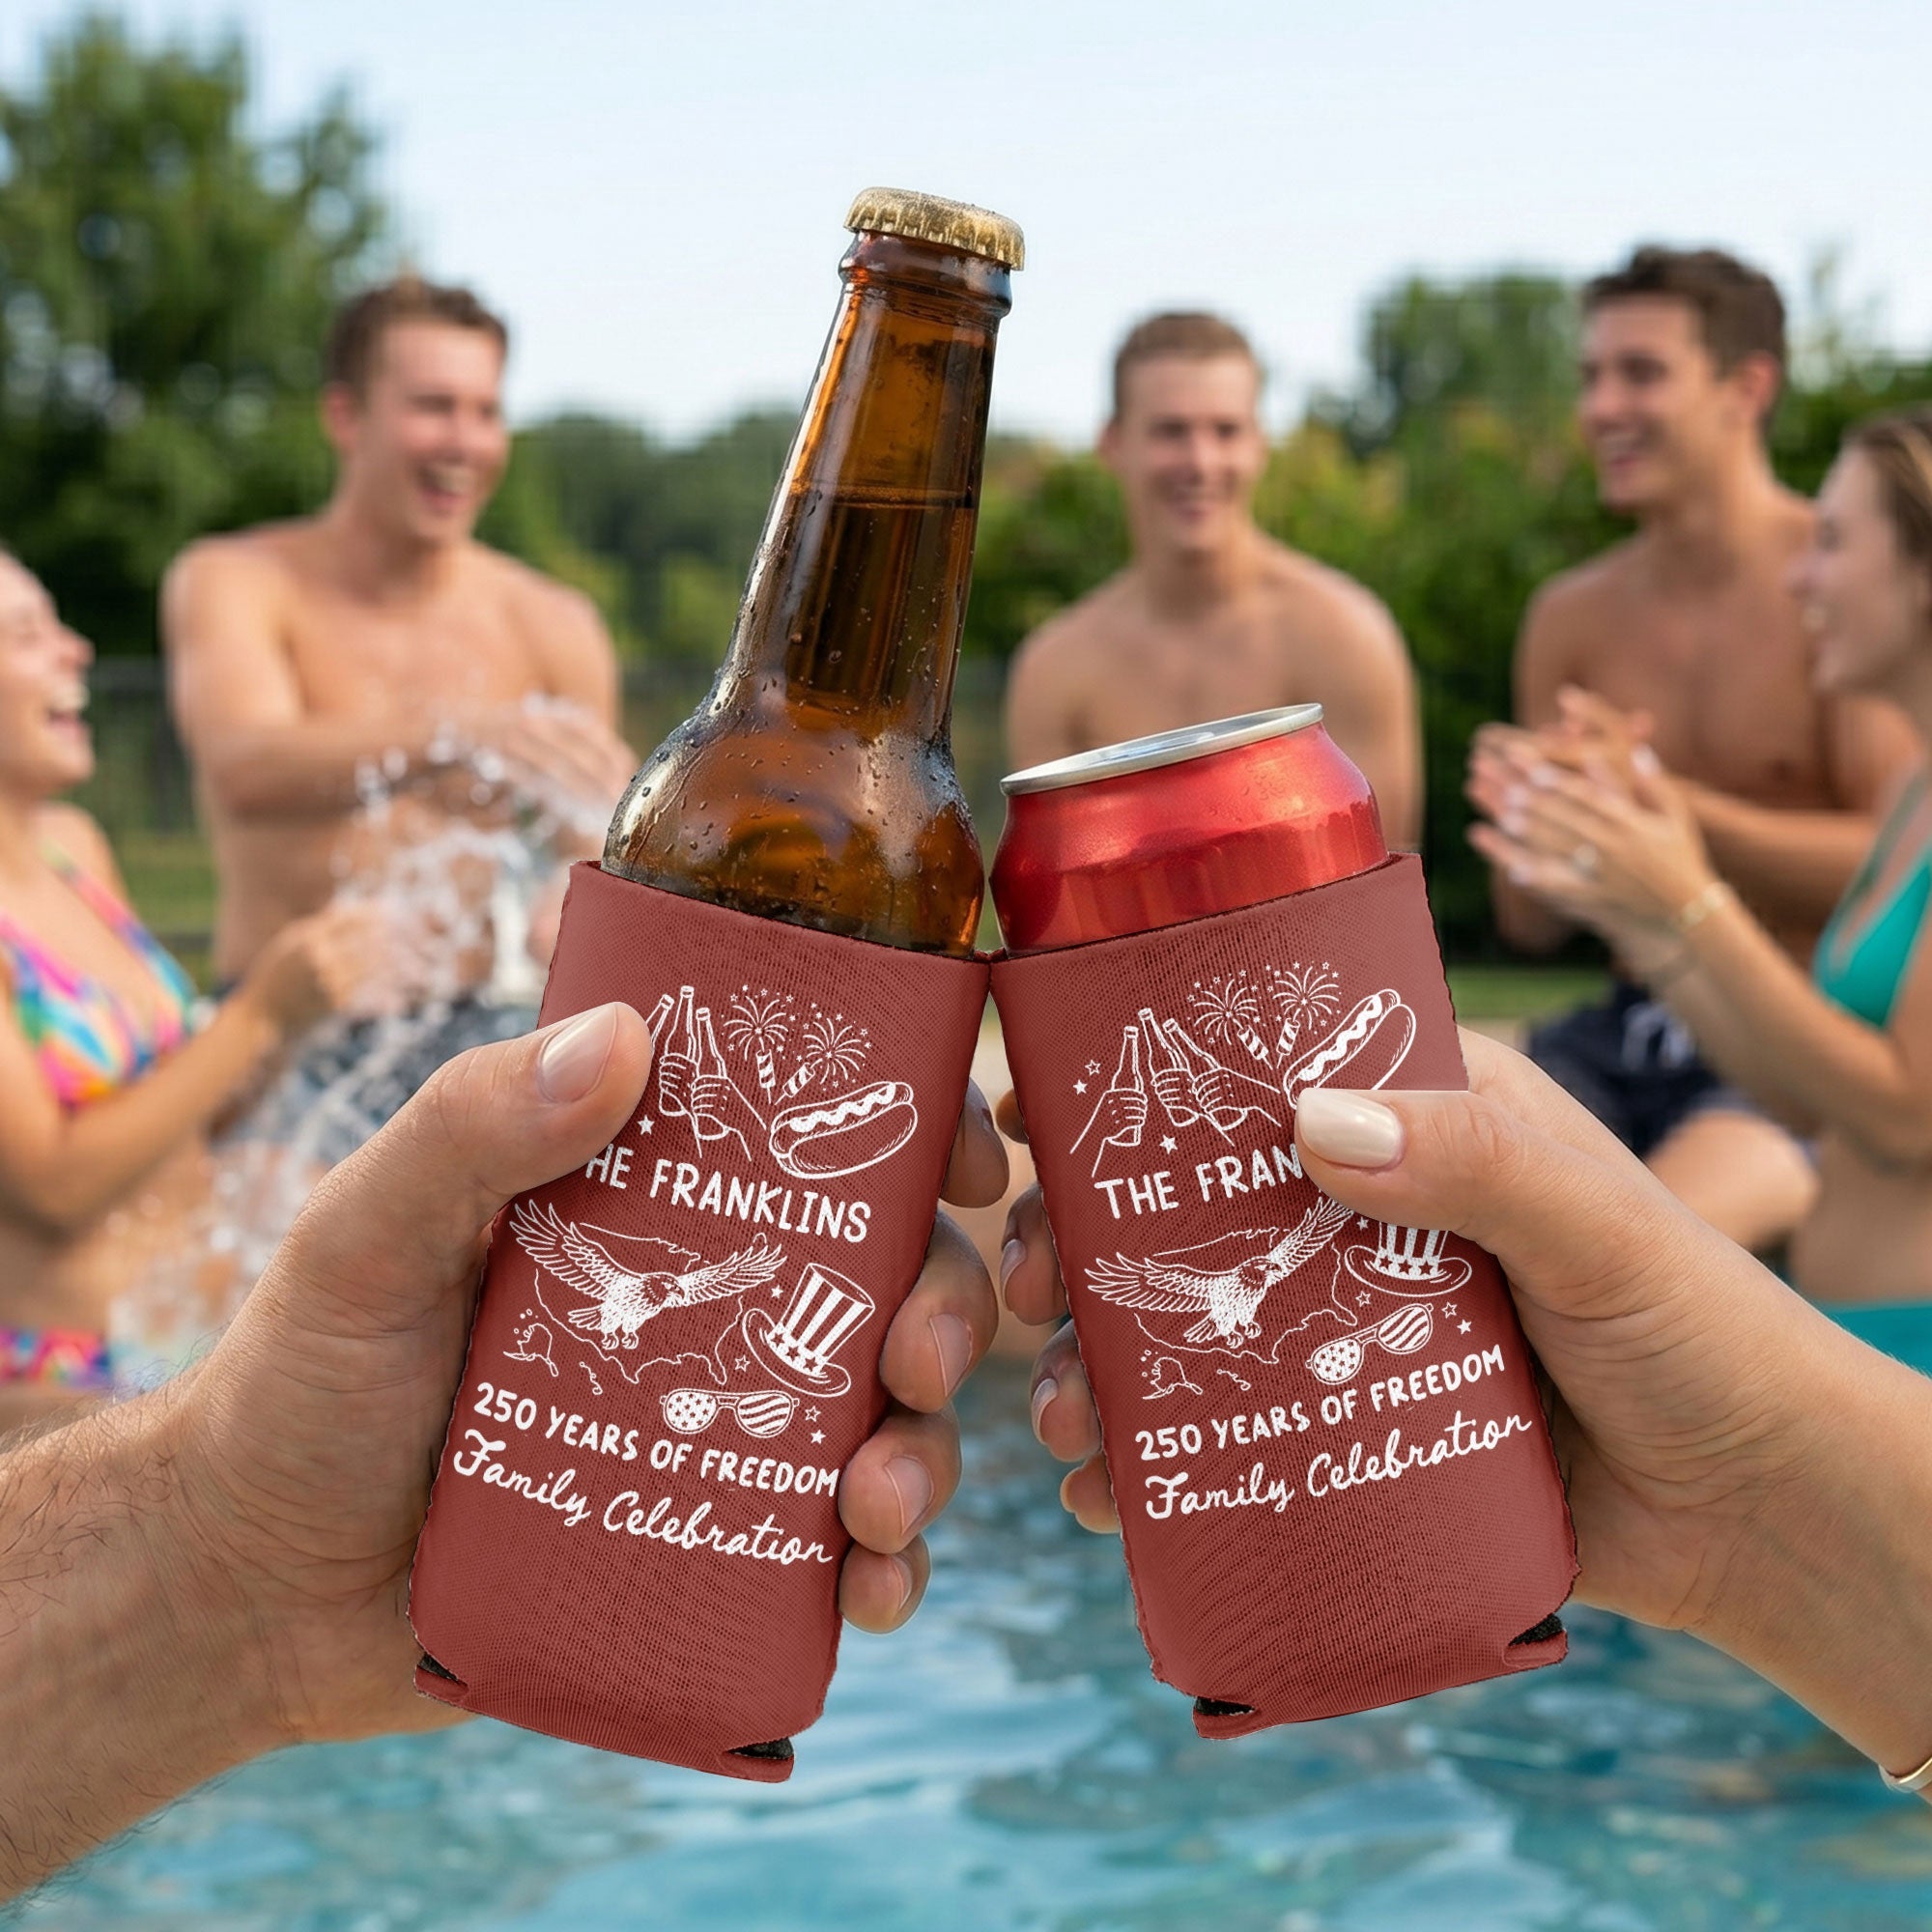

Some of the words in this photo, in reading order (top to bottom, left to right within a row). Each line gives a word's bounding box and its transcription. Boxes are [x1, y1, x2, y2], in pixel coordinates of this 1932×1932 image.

[584, 1143, 635, 1190] HE
[649, 1158, 871, 1243] FRANKLINS
[1094, 1170, 1179, 1219] THE
[473, 1381, 537, 1431] 250
[545, 1405, 639, 1462] YEARS
[649, 1437, 694, 1474] OF
[699, 1448, 839, 1497] FREEDOM
[1134, 1423, 1203, 1462] 250
[1210, 1401, 1312, 1450] YEARS
[1321, 1387, 1358, 1426] OF
[1369, 1344, 1506, 1412] FREEDOM
[453, 1429, 592, 1527] Family
[602, 1491, 834, 1565] Celebration
[1145, 1462, 1295, 1520] Family
[1306, 1409, 1533, 1498] Celebration
